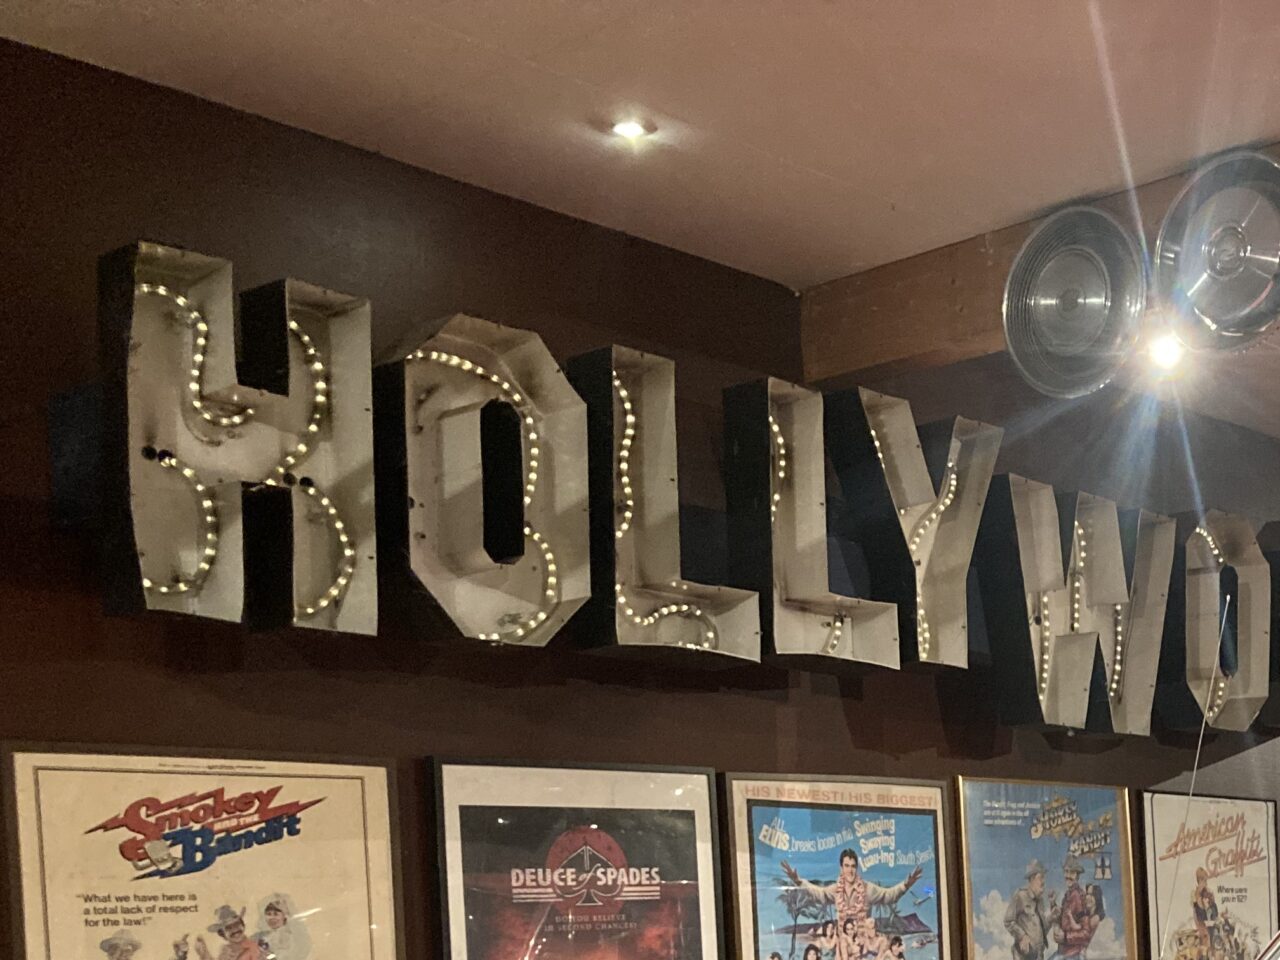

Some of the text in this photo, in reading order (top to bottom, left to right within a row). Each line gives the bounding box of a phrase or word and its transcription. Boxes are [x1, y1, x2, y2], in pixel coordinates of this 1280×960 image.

[745, 786, 771, 798] HIS
[850, 791, 872, 804] HIS
[119, 785, 284, 862] Smokey
[162, 813, 302, 878] Bandit
[1160, 812, 1246, 860] American
[1206, 828, 1266, 878] Graffiti
[511, 868, 577, 887] DEUCE
[596, 867, 661, 885] SPADES
[133, 893, 159, 902] have
[162, 893, 186, 901] here
[188, 893, 198, 901] is
[83, 904, 198, 915] a total lack of respect
[85, 918, 99, 927] for
[103, 918, 120, 926] the
